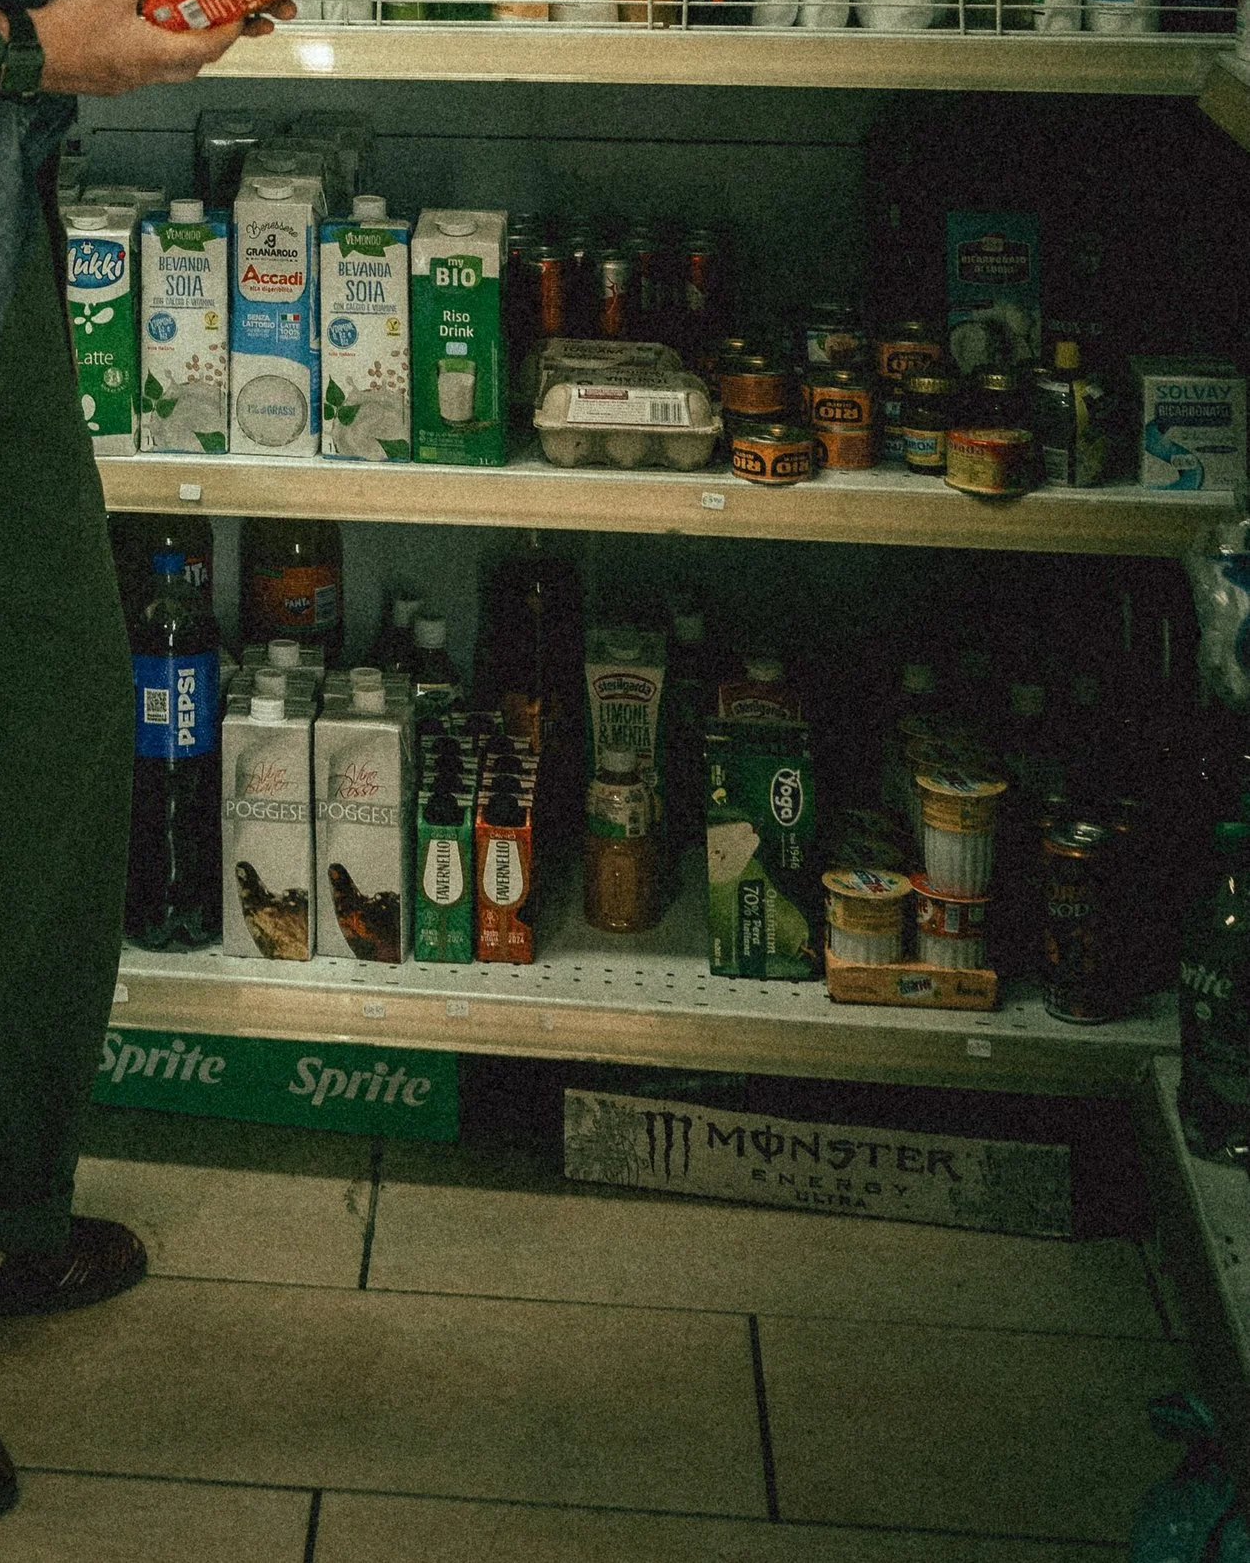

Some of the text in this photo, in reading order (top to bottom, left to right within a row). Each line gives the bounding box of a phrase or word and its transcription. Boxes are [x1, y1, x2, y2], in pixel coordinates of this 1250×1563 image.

[344, 230, 382, 246] VEMONDO
[245, 247, 299, 258] GRANAROLO
[158, 256, 211, 273] BEVANDA
[240, 263, 303, 286] Accadi
[337, 260, 392, 279] BEVANDA
[165, 273, 204, 297] SOIA
[435, 268, 478, 287] BIO
[344, 279, 385, 303] SOIA
[442, 309, 471, 323] Riso
[438, 323, 475, 338] Drink
[1155, 384, 1232, 401] SOLVAY
[819, 406, 859, 420] RIO
[177, 667, 196, 746] PEPSI
[225, 800, 307, 821] POGGESE
[317, 801, 399, 824] POGGESE
[435, 840, 451, 902] TAVERNELLO
[495, 840, 511, 903] TAVERNELLO
[97, 1031, 227, 1085] Sprite
[288, 1055, 432, 1107] Sprite
[705, 1121, 963, 1183] MONSTER
[751, 1169, 909, 1198] ENERGY
[795, 1190, 868, 1210] ULTRA
